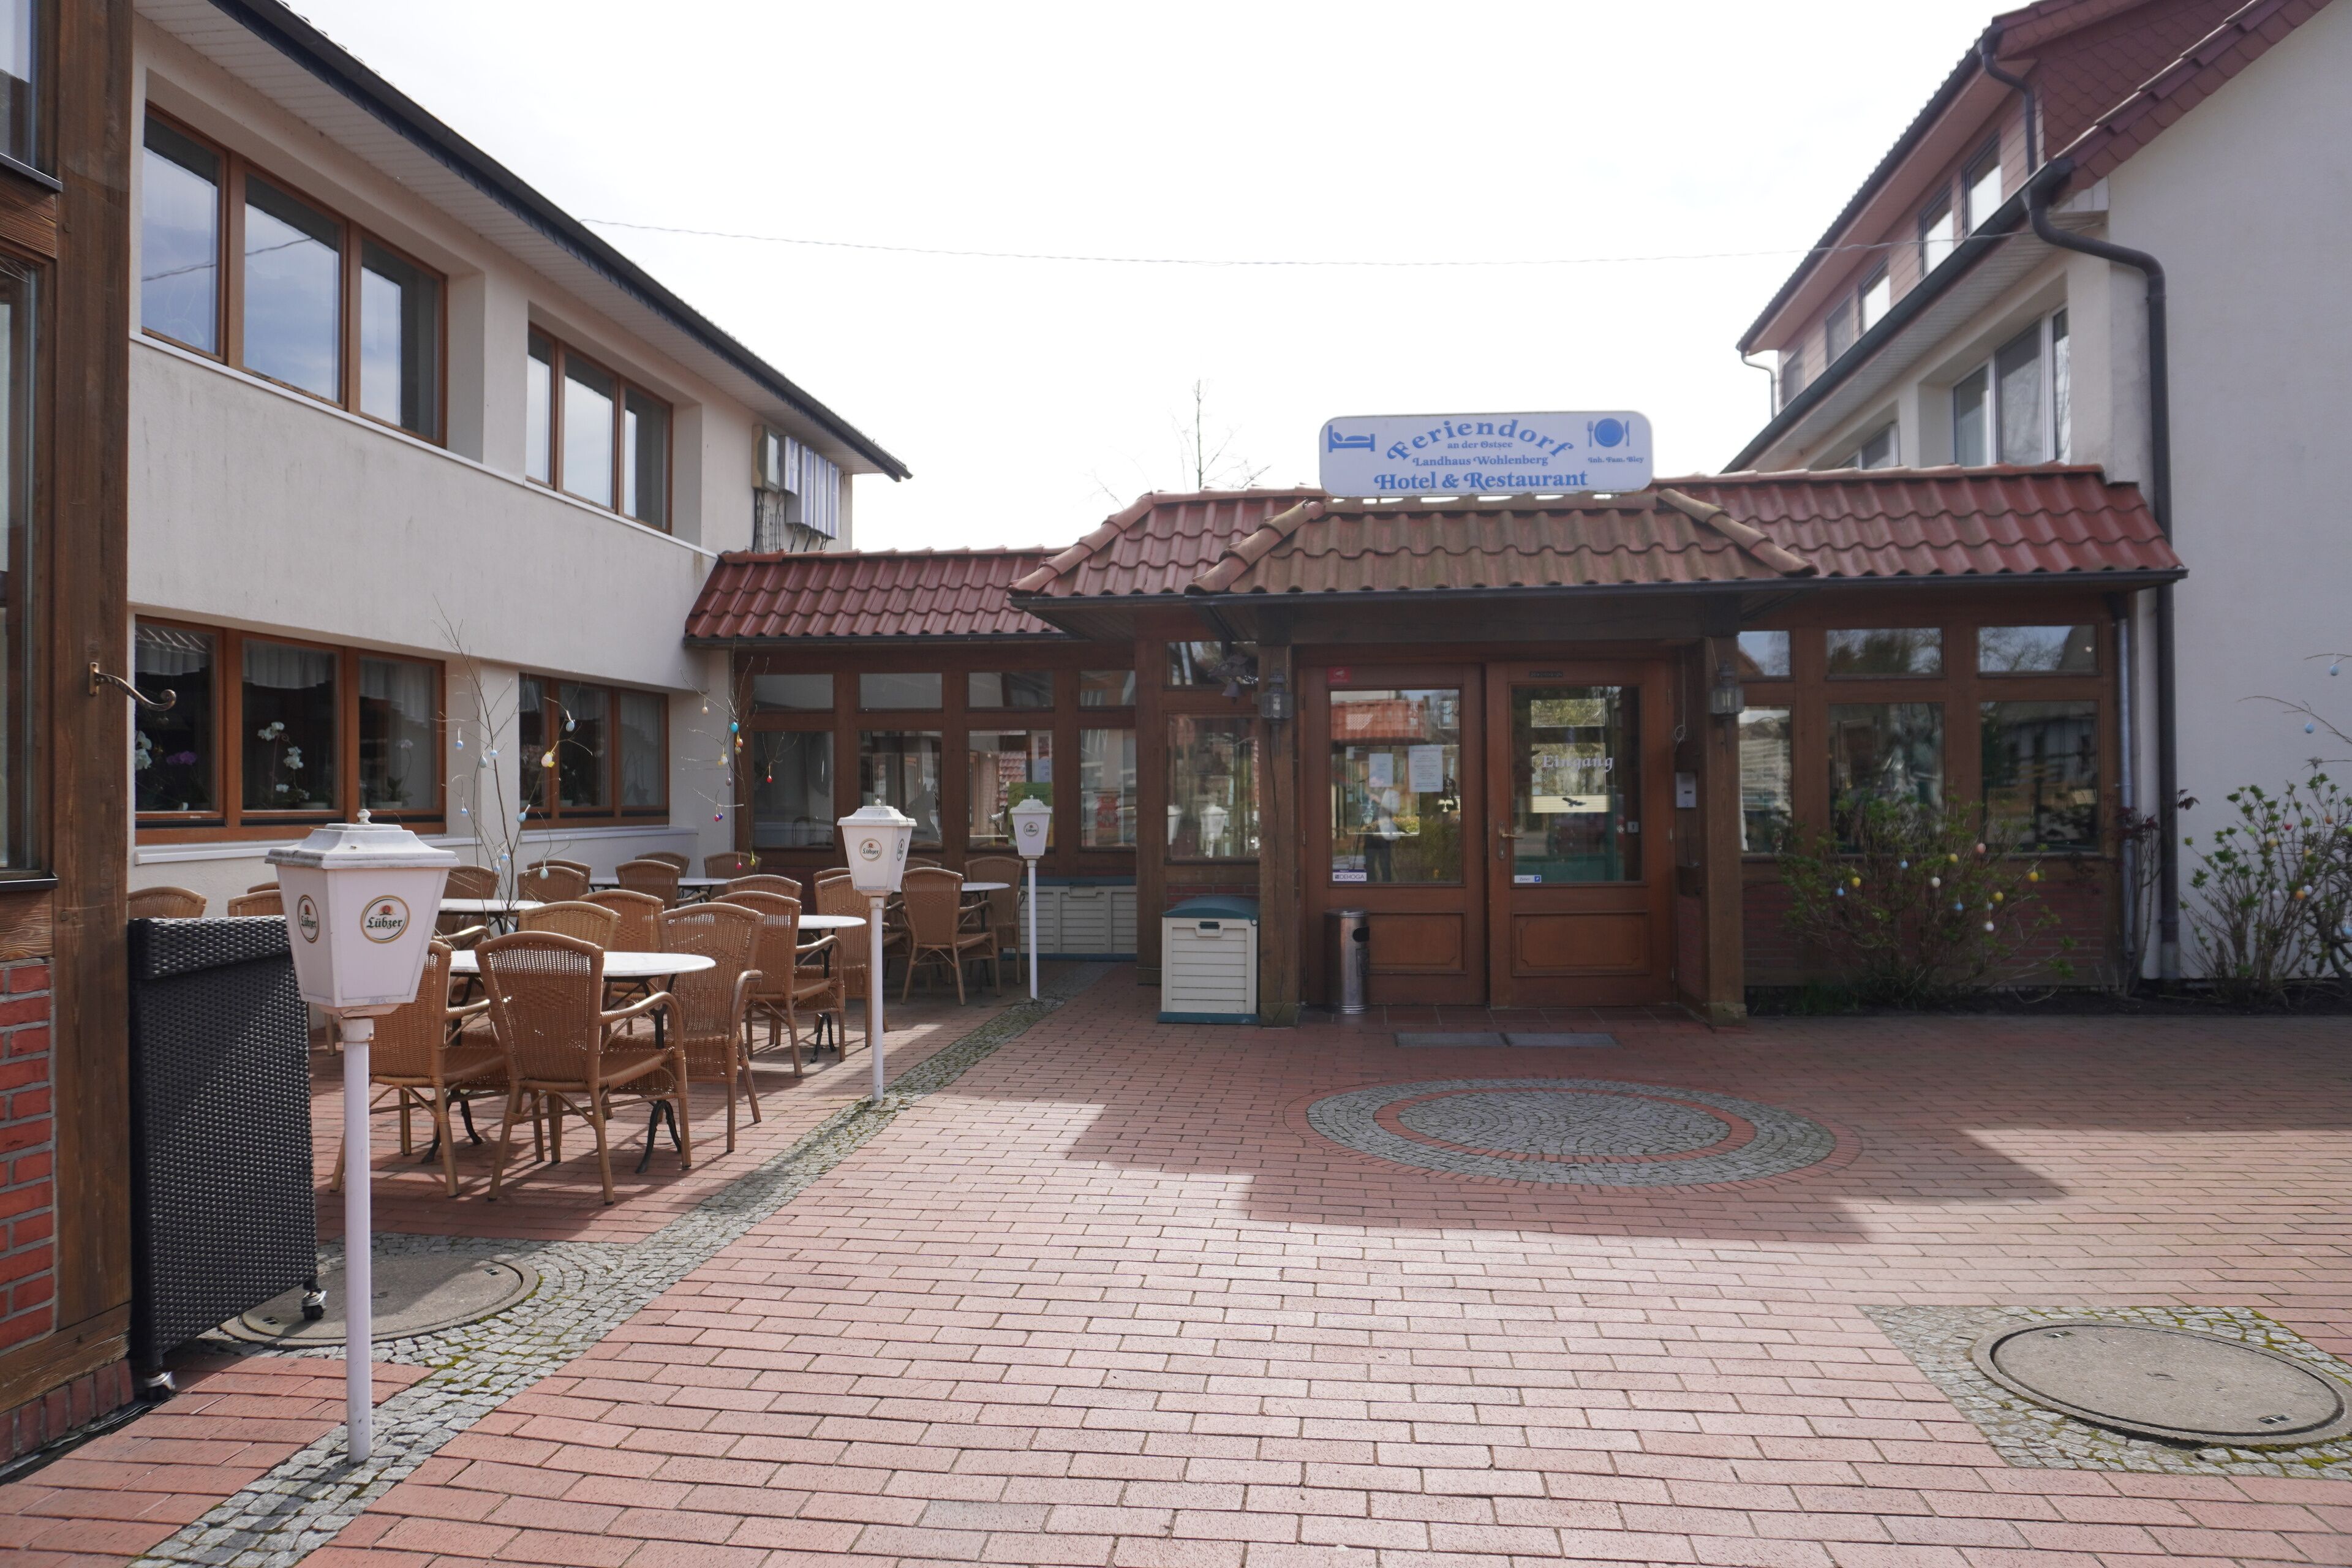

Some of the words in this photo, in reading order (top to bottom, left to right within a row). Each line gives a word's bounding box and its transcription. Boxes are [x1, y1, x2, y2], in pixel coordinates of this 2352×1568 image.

[1387, 419, 1574, 461] Feriendorf
[1412, 456, 1471, 466] Landhaus
[1473, 454, 1549, 466] Wohlenberg
[1374, 471, 1437, 490] Hotel
[1442, 473, 1460, 489] &
[1463, 470, 1589, 491] Restaurant
[1543, 754, 1613, 773] Eingang
[301, 916, 317, 929] Lübzer
[366, 916, 403, 929] Lübzer
